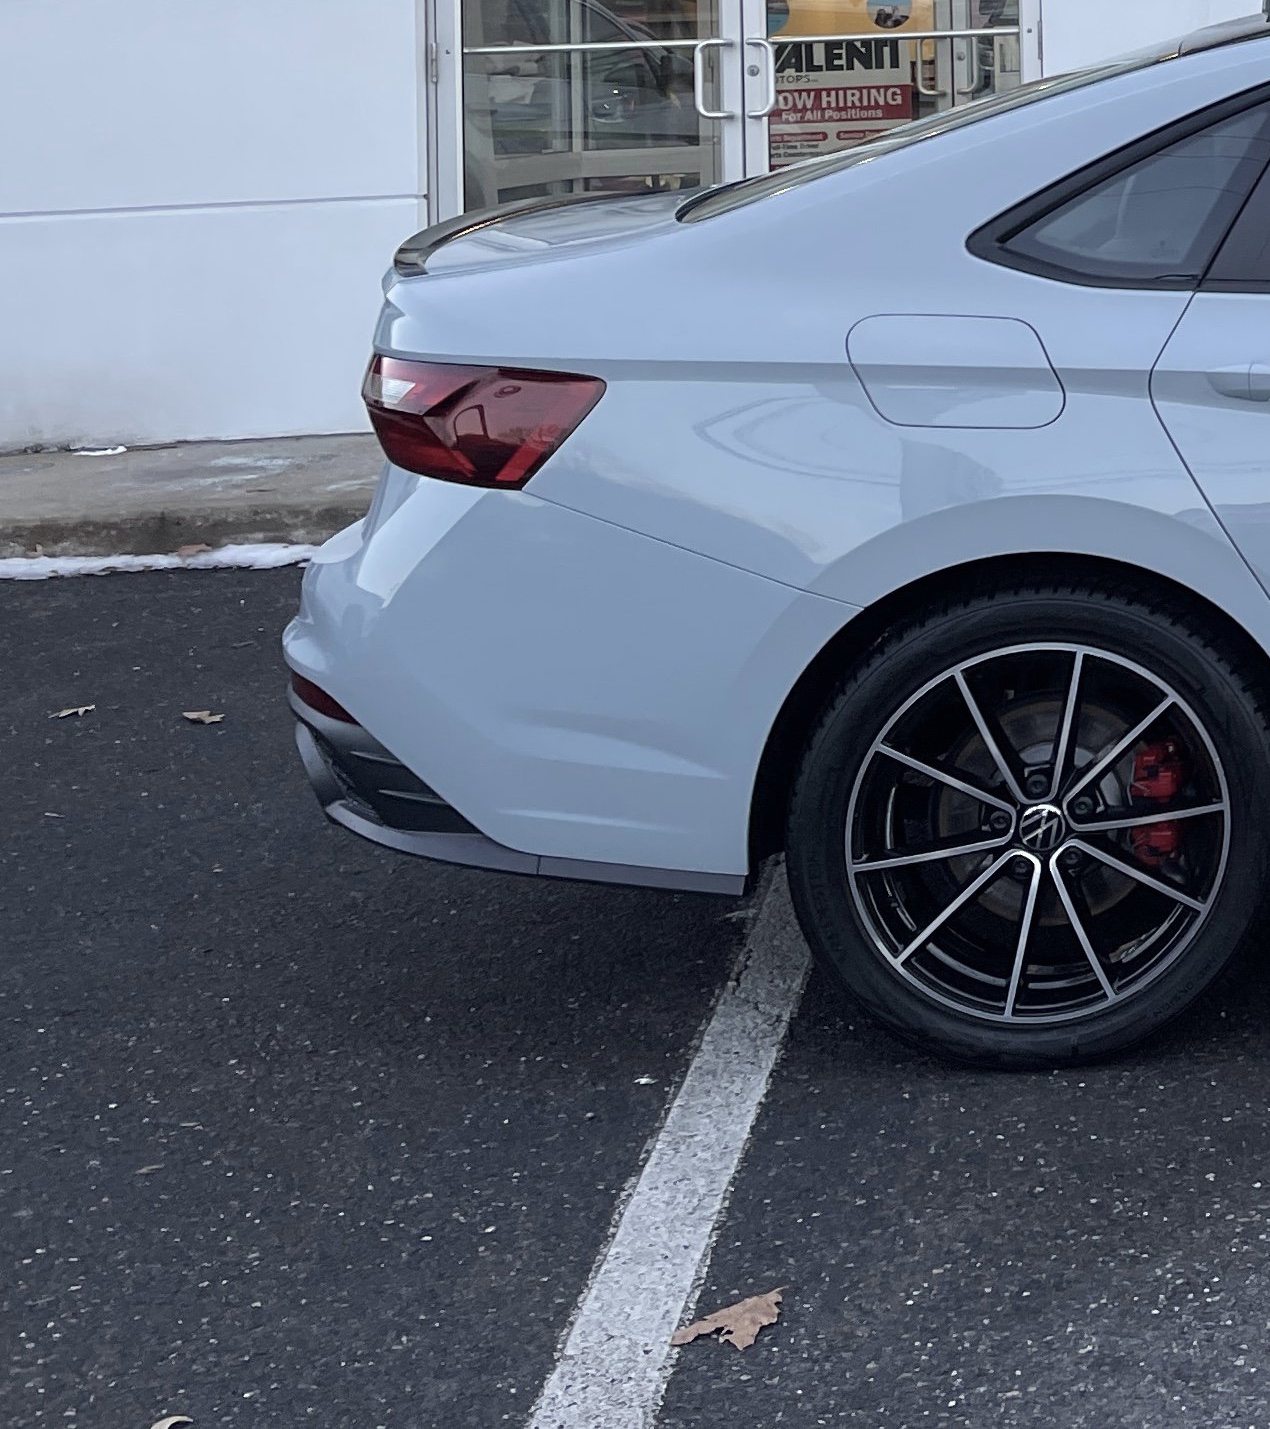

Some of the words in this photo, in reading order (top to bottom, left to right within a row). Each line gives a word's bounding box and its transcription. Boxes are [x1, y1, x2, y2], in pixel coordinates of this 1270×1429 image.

[775, 74, 810, 84] TORS
[778, 92, 815, 110] OW
[821, 88, 902, 107] HIRING
[782, 112, 800, 122] For
[805, 110, 821, 120] All
[825, 108, 882, 119] Positions
